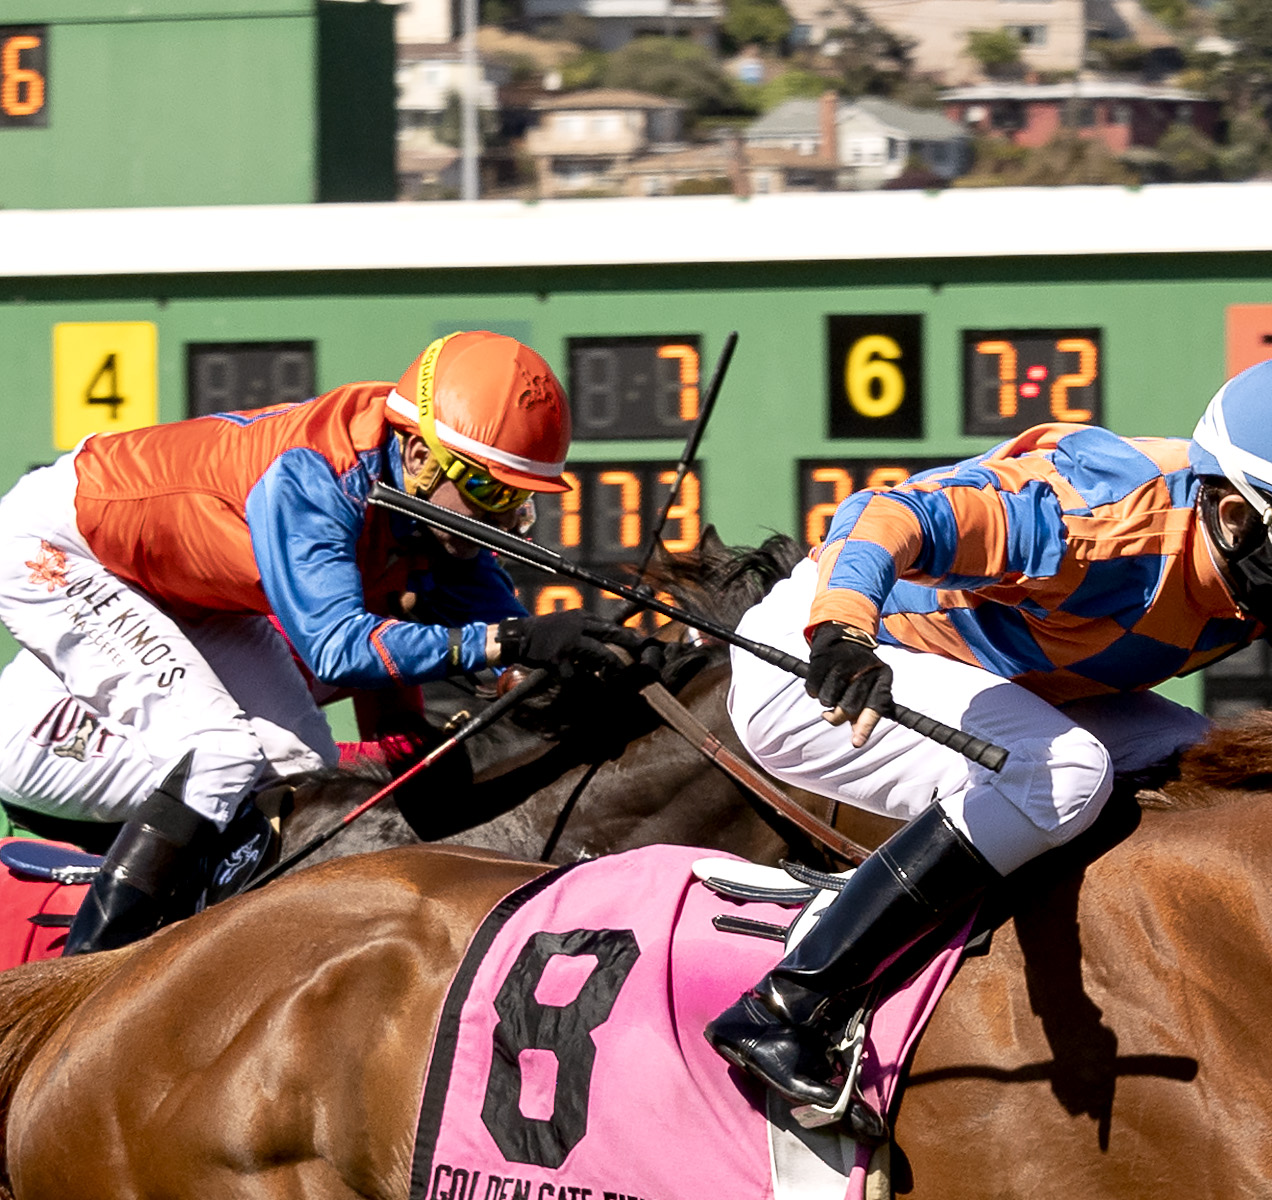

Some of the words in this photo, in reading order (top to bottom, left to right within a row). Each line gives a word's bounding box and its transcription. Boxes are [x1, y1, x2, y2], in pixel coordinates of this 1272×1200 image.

[84, 352, 126, 419] 4
[657, 344, 700, 421] 7
[844, 334, 906, 418] 6
[481, 928, 641, 1170] 8
